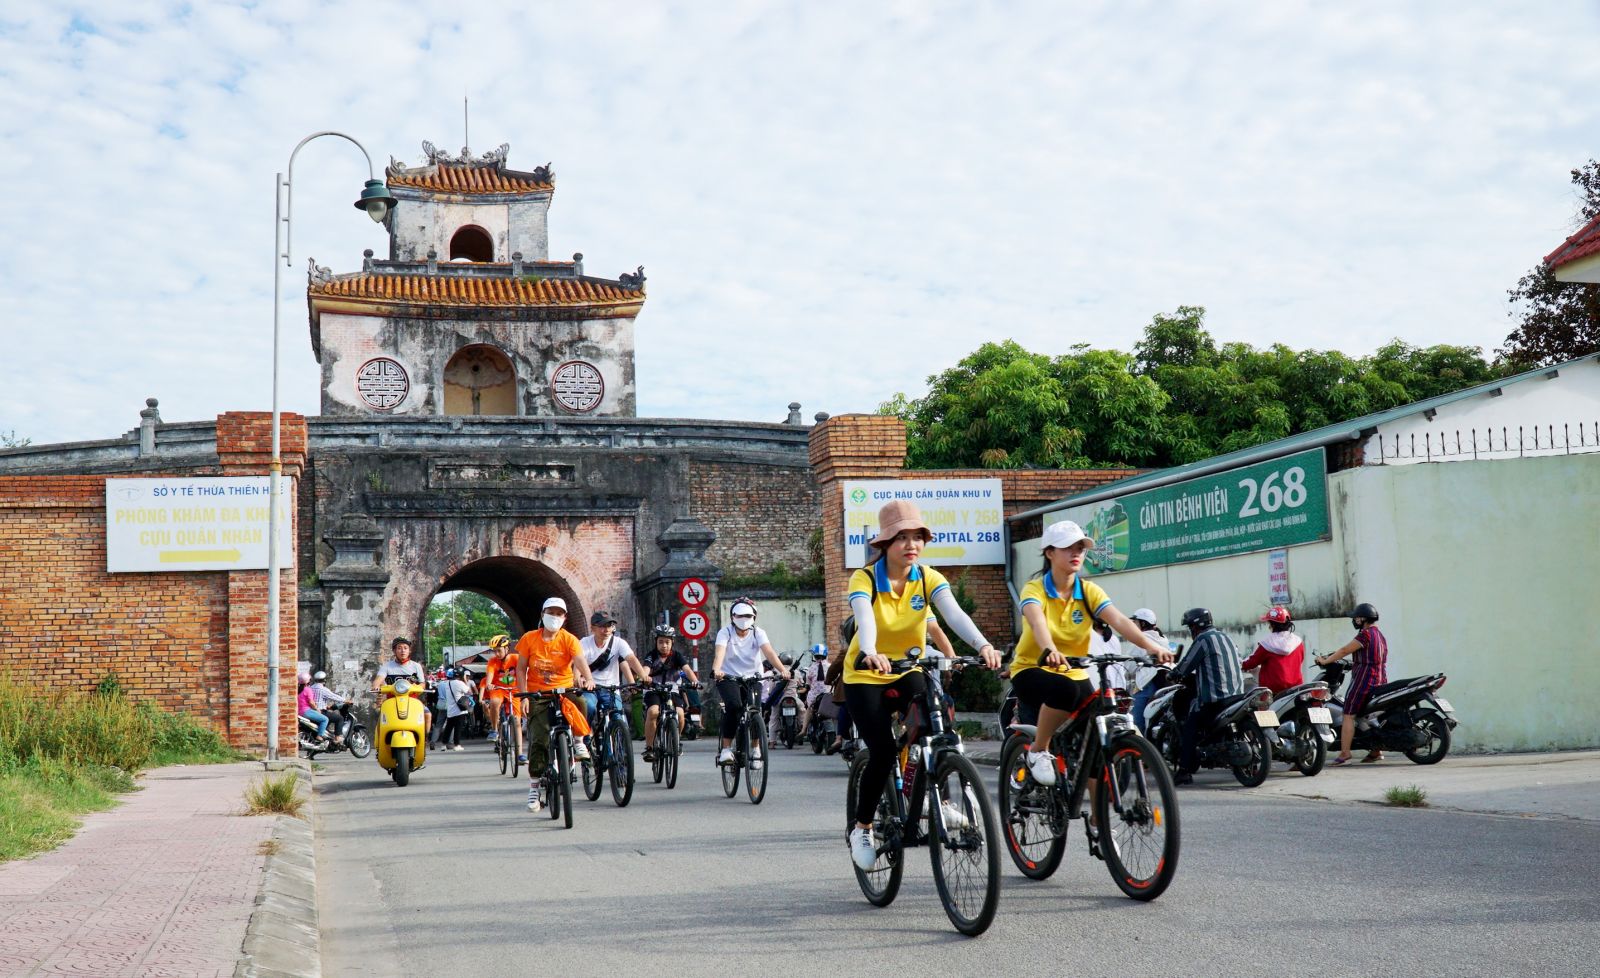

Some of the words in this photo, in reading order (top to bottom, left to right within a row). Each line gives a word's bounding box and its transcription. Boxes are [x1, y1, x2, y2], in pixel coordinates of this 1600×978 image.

[171, 487, 177, 496] Y
[180, 484, 194, 496] TẾ
[228, 484, 259, 495] THIÊN
[962, 489, 980, 498] KHU
[983, 489, 991, 497] IV
[1140, 501, 1157, 529] CĂN
[1158, 501, 1175, 526] TIN
[1176, 492, 1203, 528] BỆNH
[1203, 486, 1229, 522] VIỆN
[1238, 466, 1308, 518] 268
[975, 509, 999, 525] 268
[931, 532, 973, 543] SPITAL
[977, 532, 1000, 543] 268
